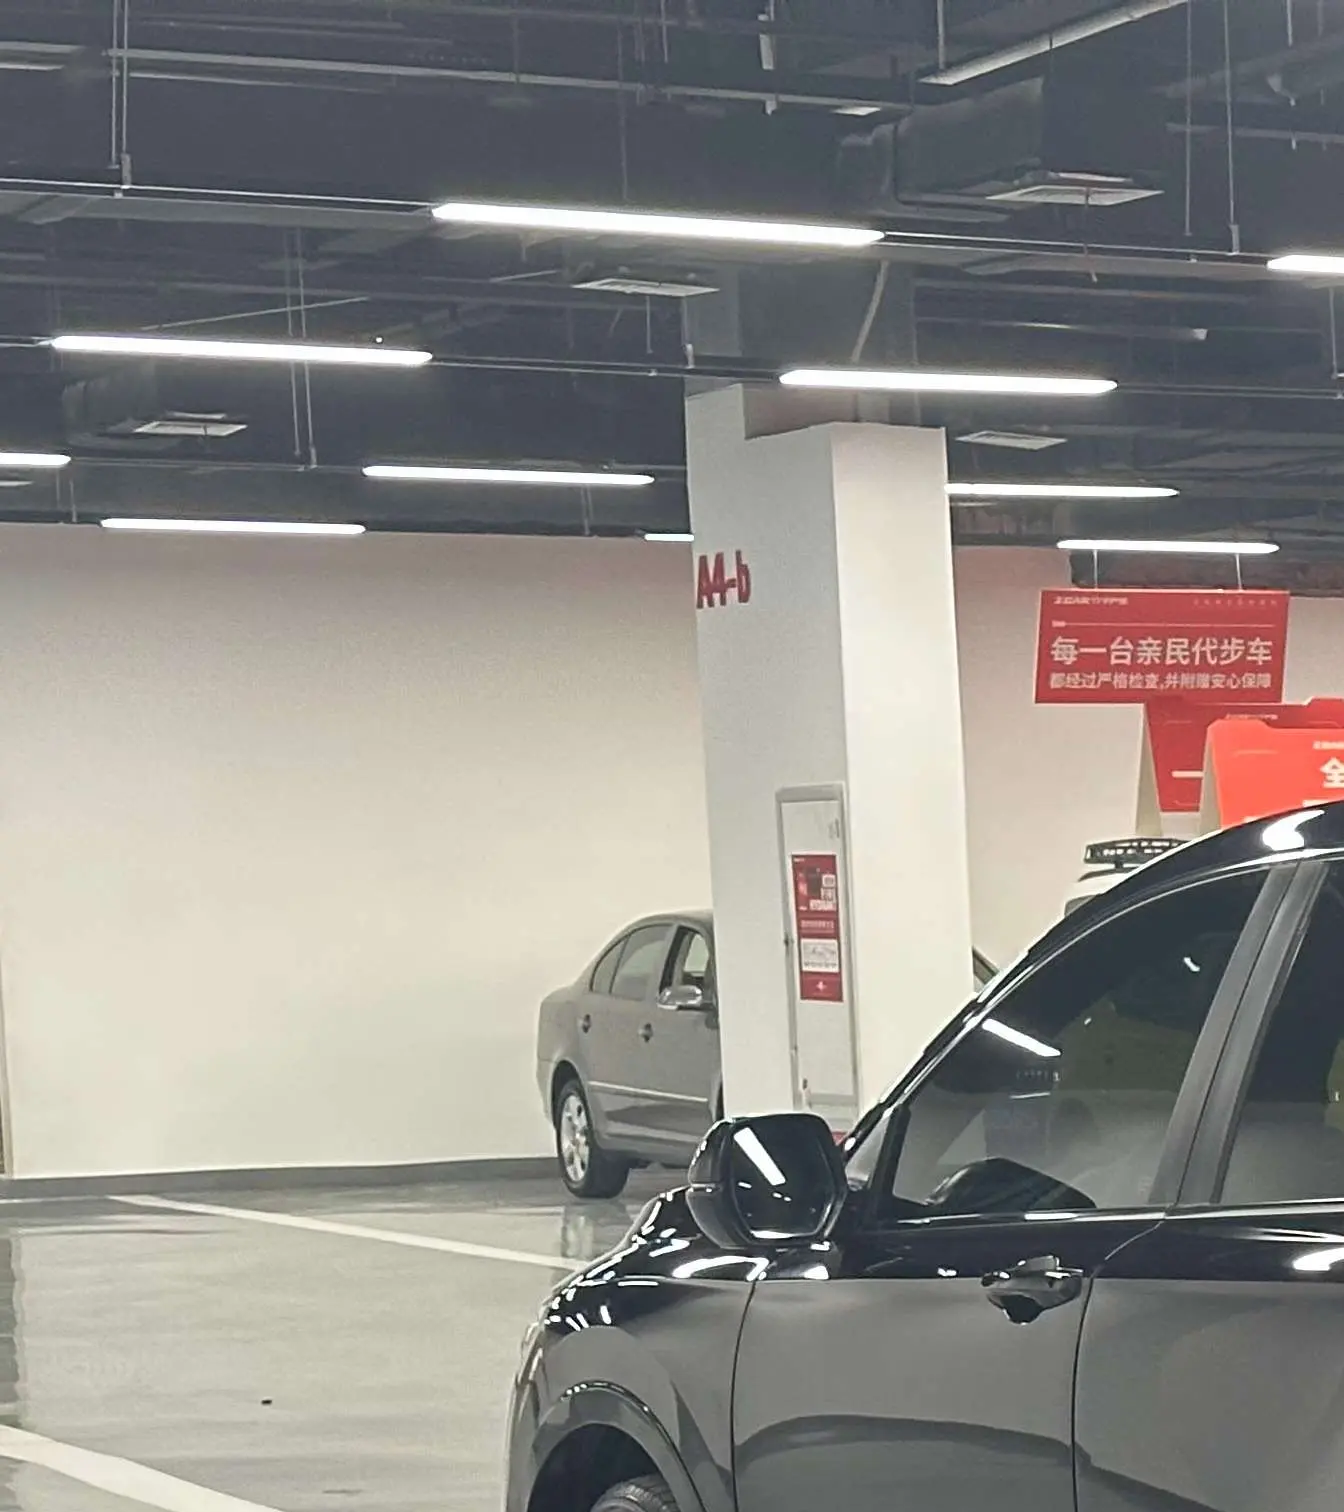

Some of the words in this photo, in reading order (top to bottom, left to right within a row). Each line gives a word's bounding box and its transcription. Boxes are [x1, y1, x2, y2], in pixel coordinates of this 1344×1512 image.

[696, 549, 751, 610] A4-b
[1051, 636, 1274, 666] 每一台亲民代步车
